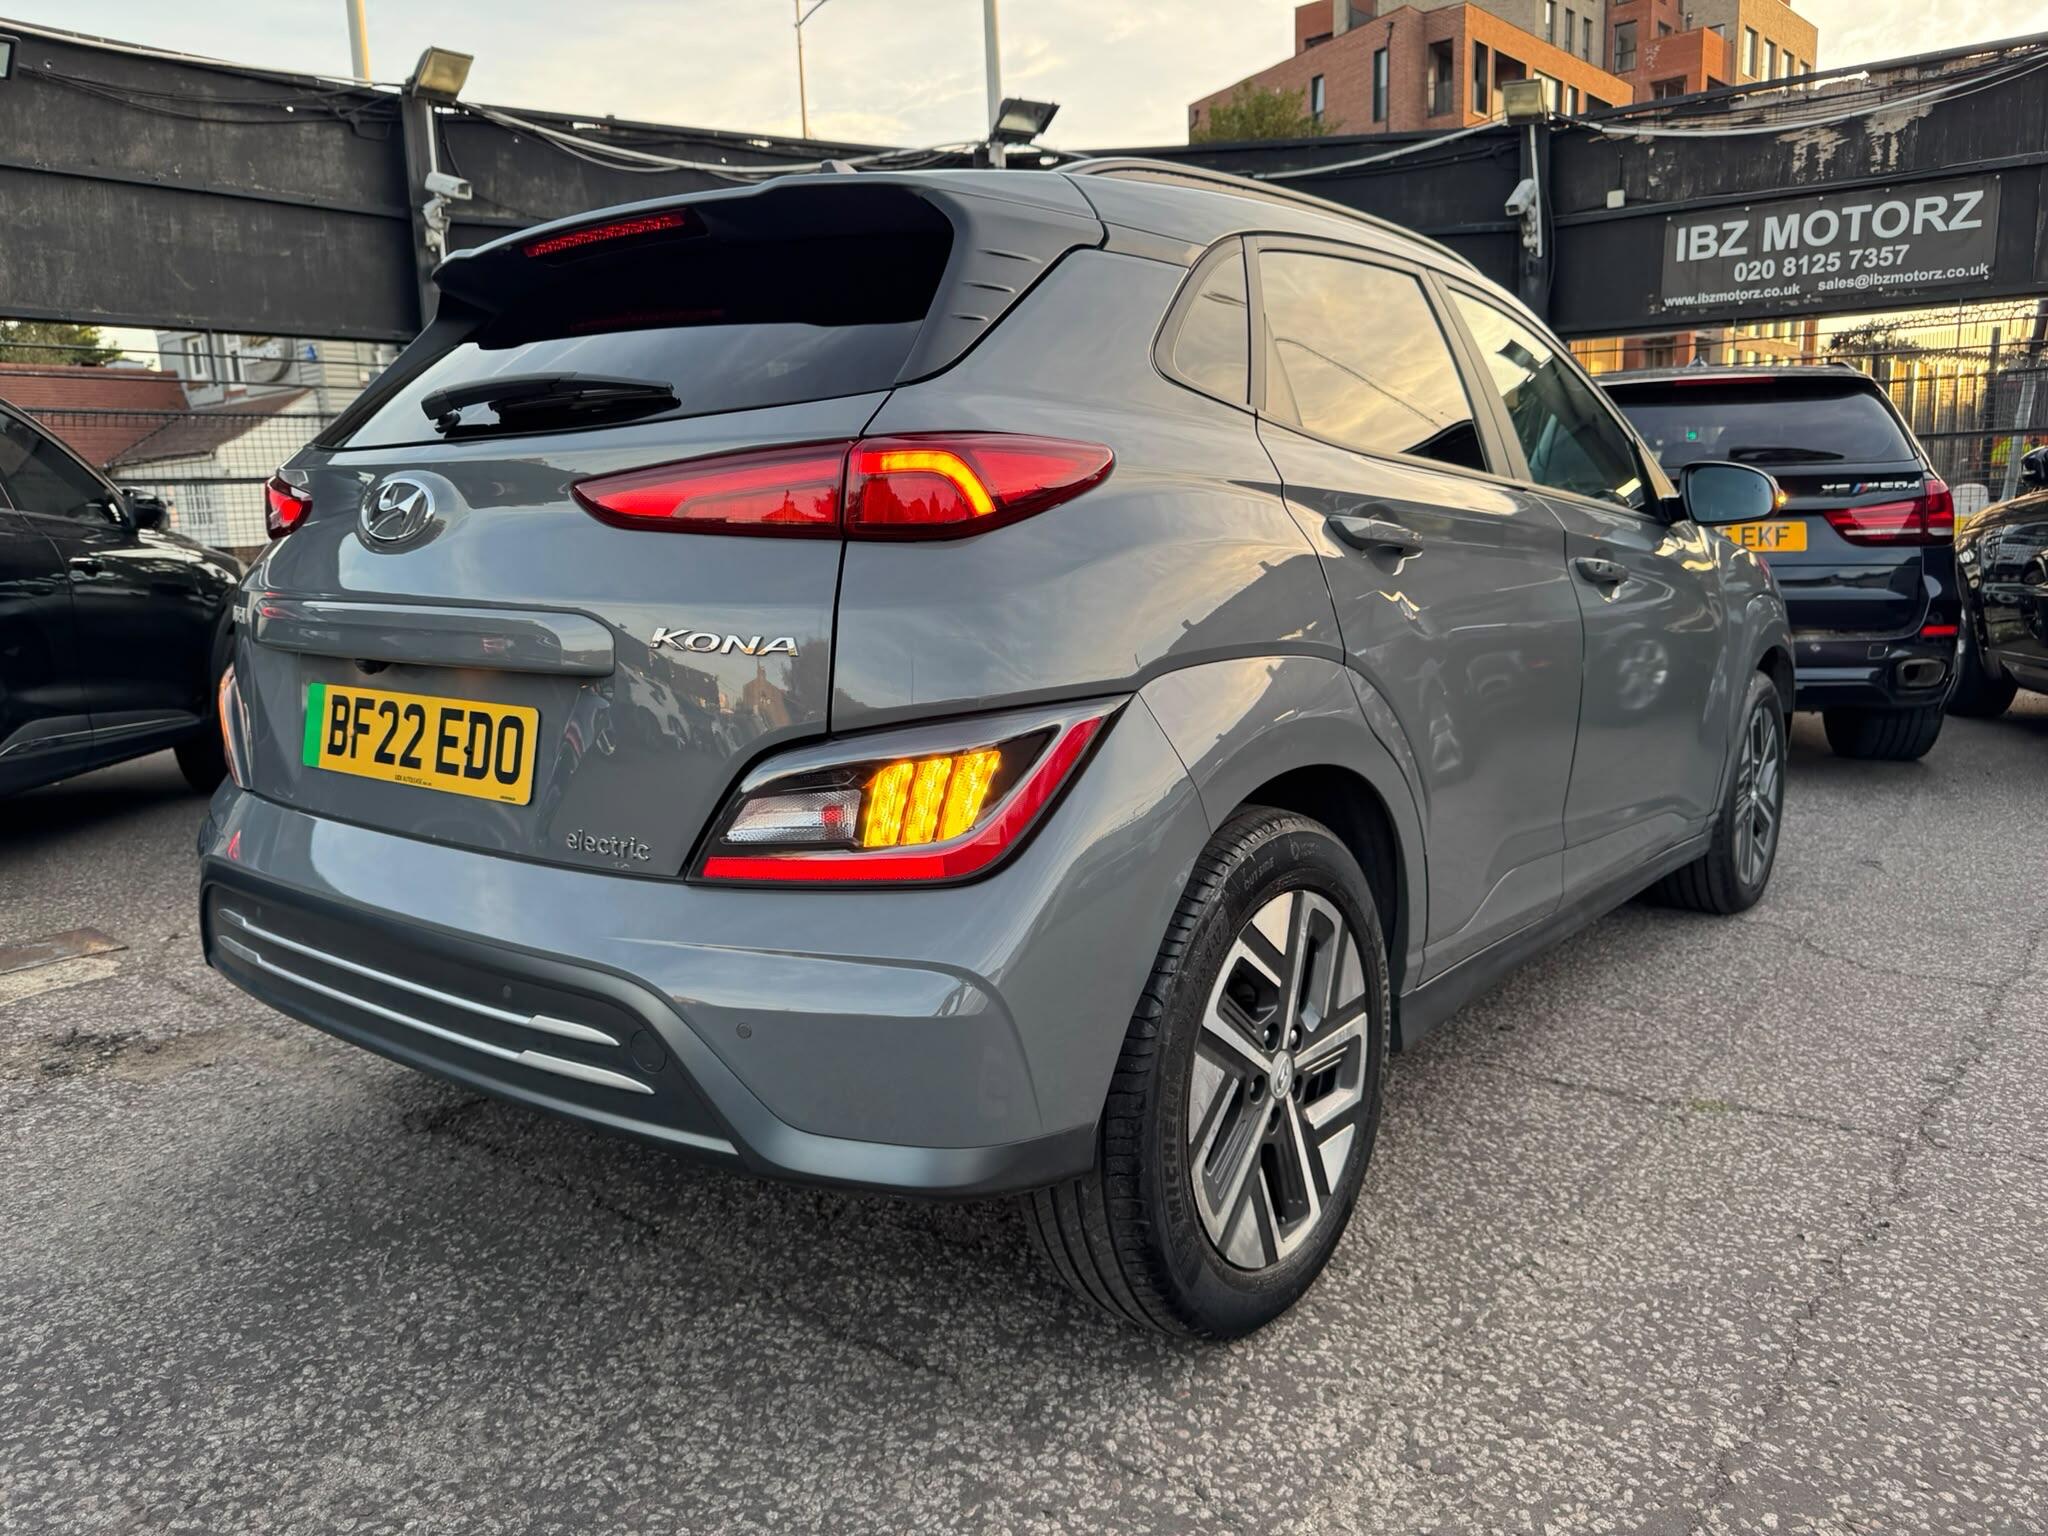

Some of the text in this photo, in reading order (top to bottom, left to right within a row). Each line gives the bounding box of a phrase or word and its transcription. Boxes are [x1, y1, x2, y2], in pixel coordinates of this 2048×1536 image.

[1675, 190, 1984, 262] IBZ MOTORZ
[1734, 244, 1910, 283] 020 8125 7357
[1664, 263, 1989, 308] www.ibzmotorz.co.uk sales@ibzmotorz.co.uk
[1741, 526, 1790, 547] EKF
[650, 627, 799, 657] KONA
[327, 694, 525, 785] BF22 EDO
[566, 829, 650, 861] electric
